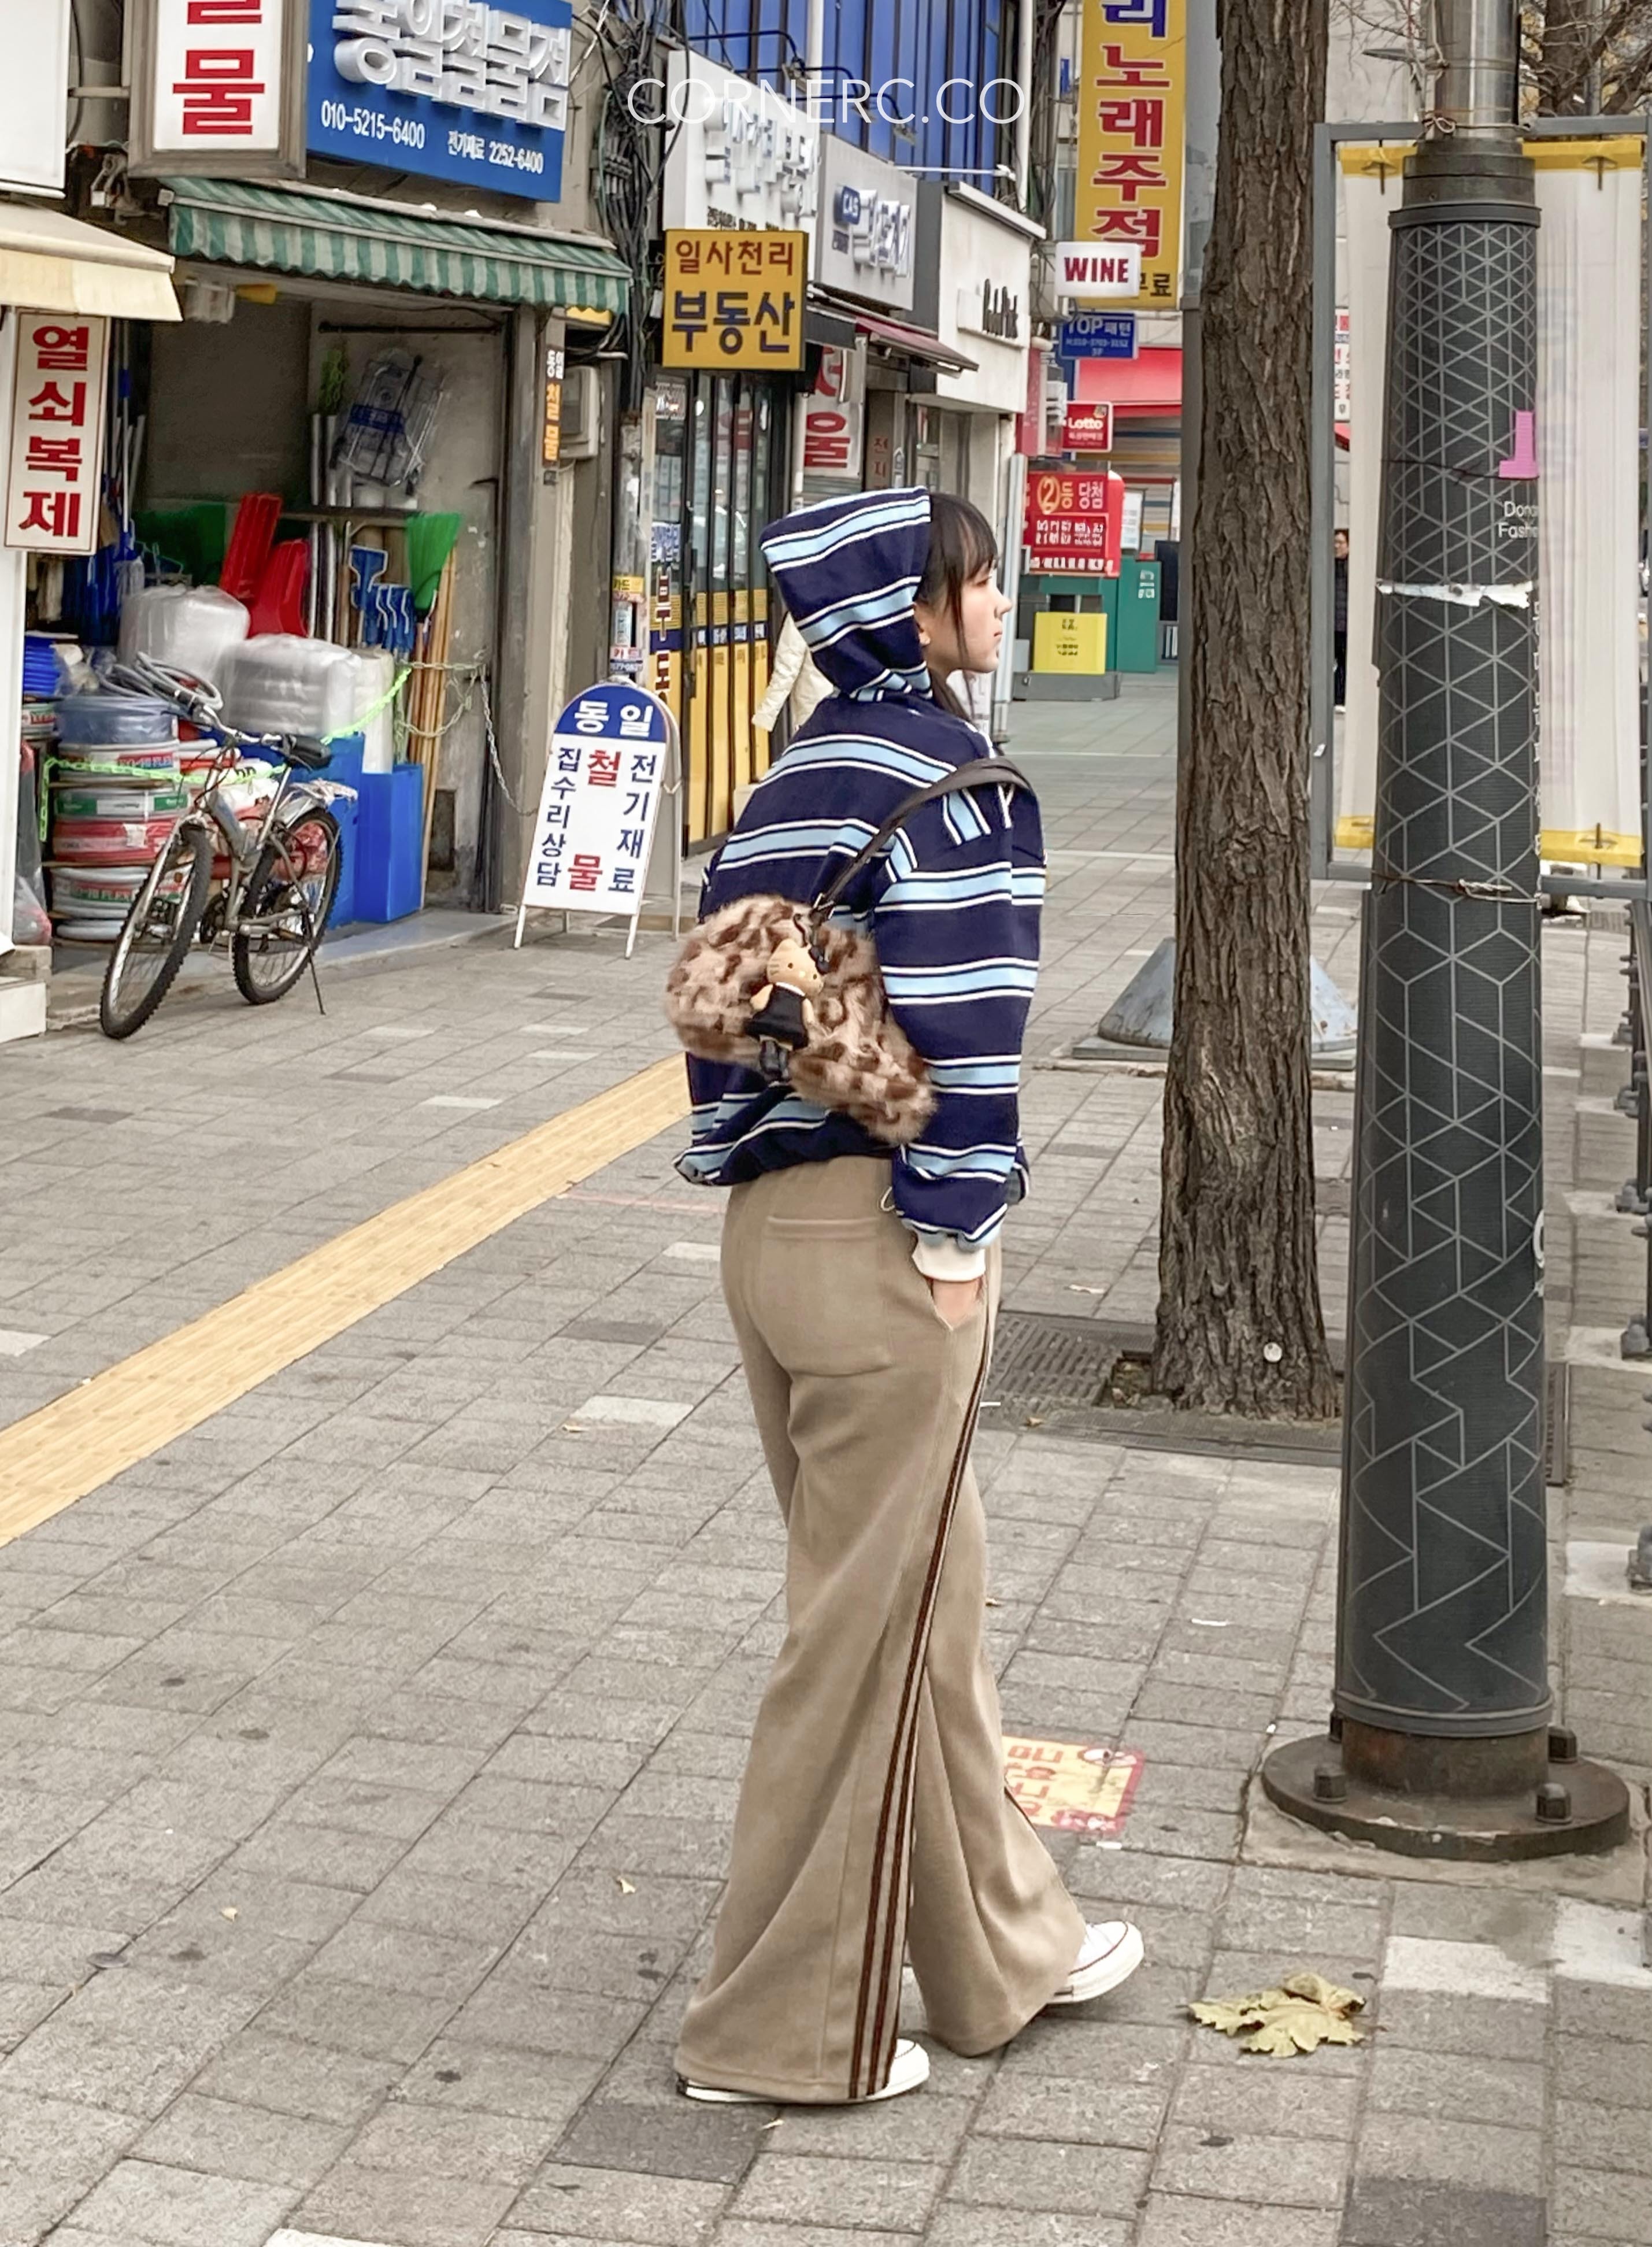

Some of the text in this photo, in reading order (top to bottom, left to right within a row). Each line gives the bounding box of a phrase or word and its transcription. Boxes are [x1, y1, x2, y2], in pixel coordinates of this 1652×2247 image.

[173, 0, 265, 135] 물
[320, 99, 426, 150] 010-5215-6400
[489, 140, 544, 175] 2252-6400
[1091, 45, 1171, 258] 노래주점
[675, 239, 794, 276] 일사천리
[1064, 257, 1129, 283] WINE
[671, 290, 795, 354] 부동산
[18, 325, 90, 538] 열쇠복제
[1068, 417, 1103, 430] Lotto
[1079, 481, 1104, 509] 당첨
[573, 700, 654, 737] 동일
[608, 753, 657, 894] 전기재료
